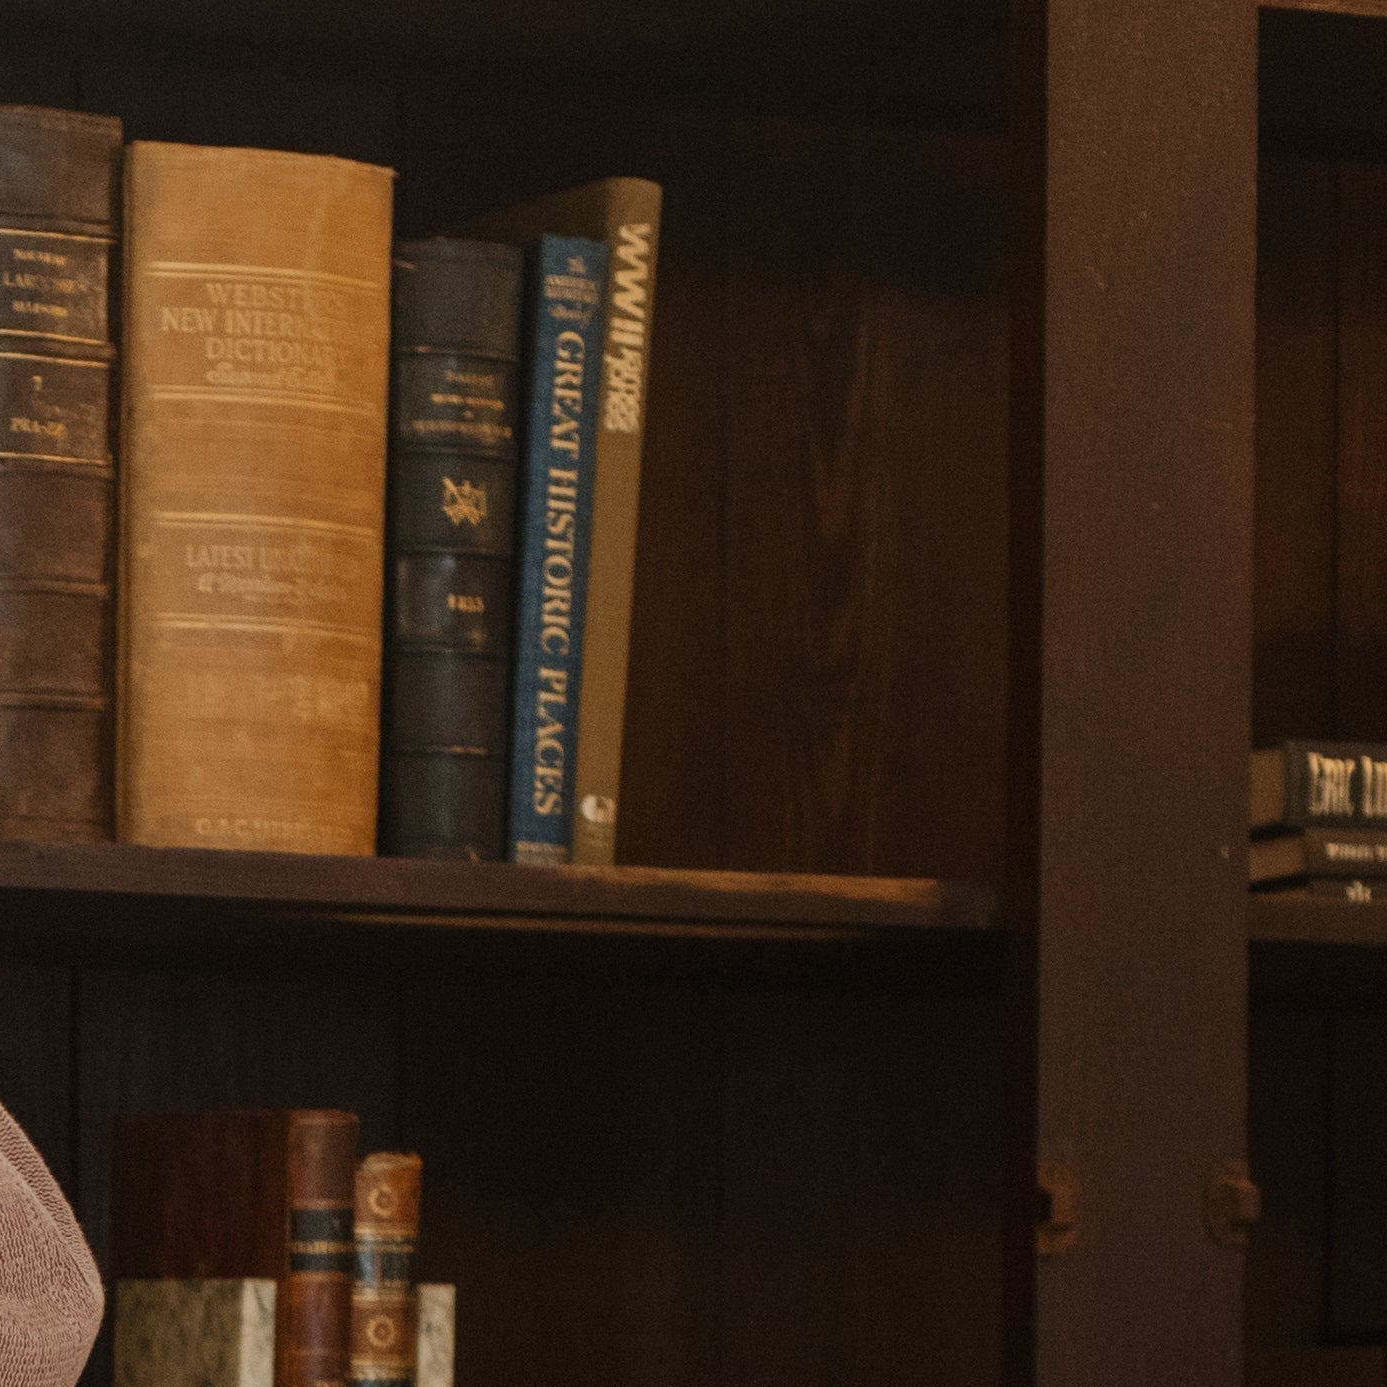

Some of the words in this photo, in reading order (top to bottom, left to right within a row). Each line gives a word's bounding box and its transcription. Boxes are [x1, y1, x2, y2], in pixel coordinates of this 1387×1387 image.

[162, 307, 217, 333] NEW
[551, 330, 585, 459] GREAT
[540, 468, 579, 656] HISTORIC
[532, 665, 569, 816] PLACES
